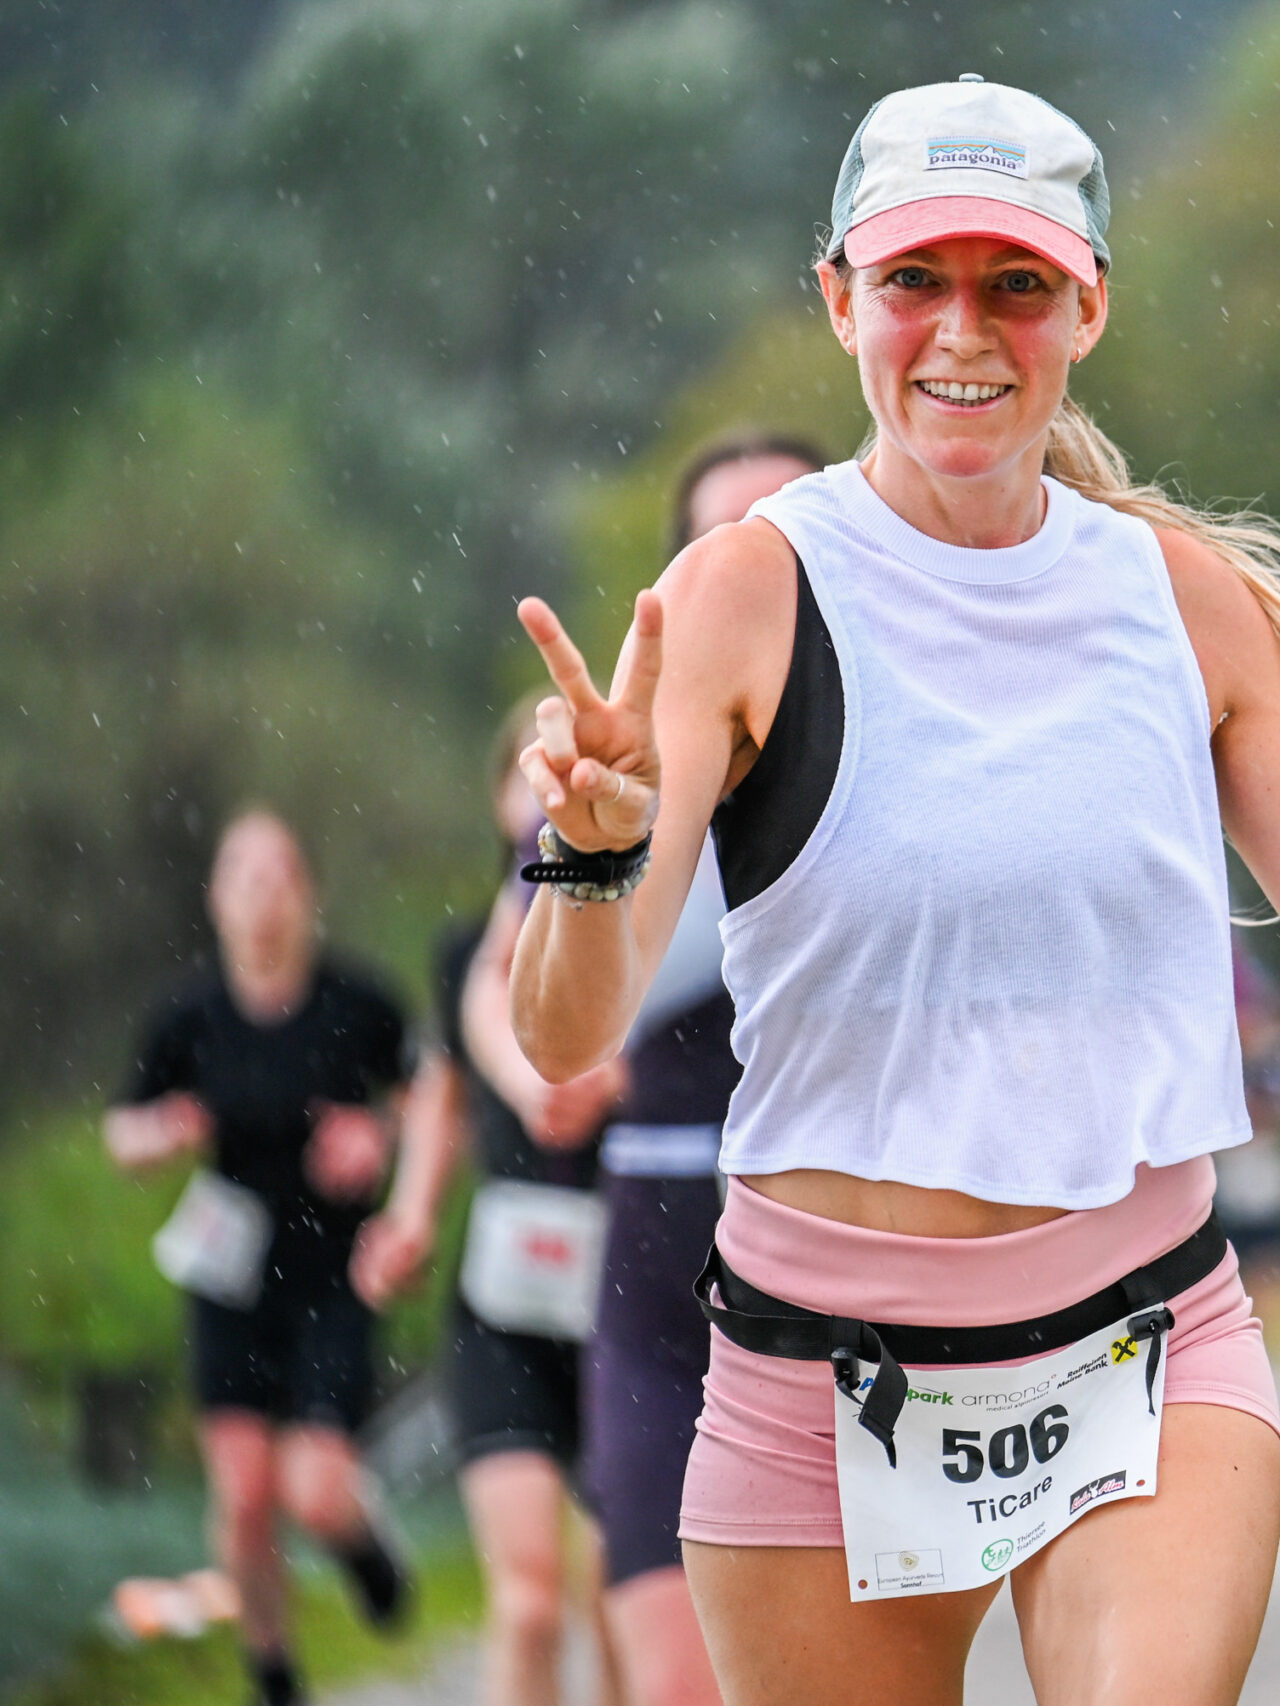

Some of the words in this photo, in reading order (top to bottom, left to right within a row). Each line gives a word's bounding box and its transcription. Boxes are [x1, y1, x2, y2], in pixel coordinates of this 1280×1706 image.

[929, 152, 1016, 169] patagonia
[1085, 1360, 1108, 1375] Bank
[961, 1380, 1050, 1407] armona
[942, 1404, 1069, 1484] 506
[967, 1475, 1052, 1524] TiCare
